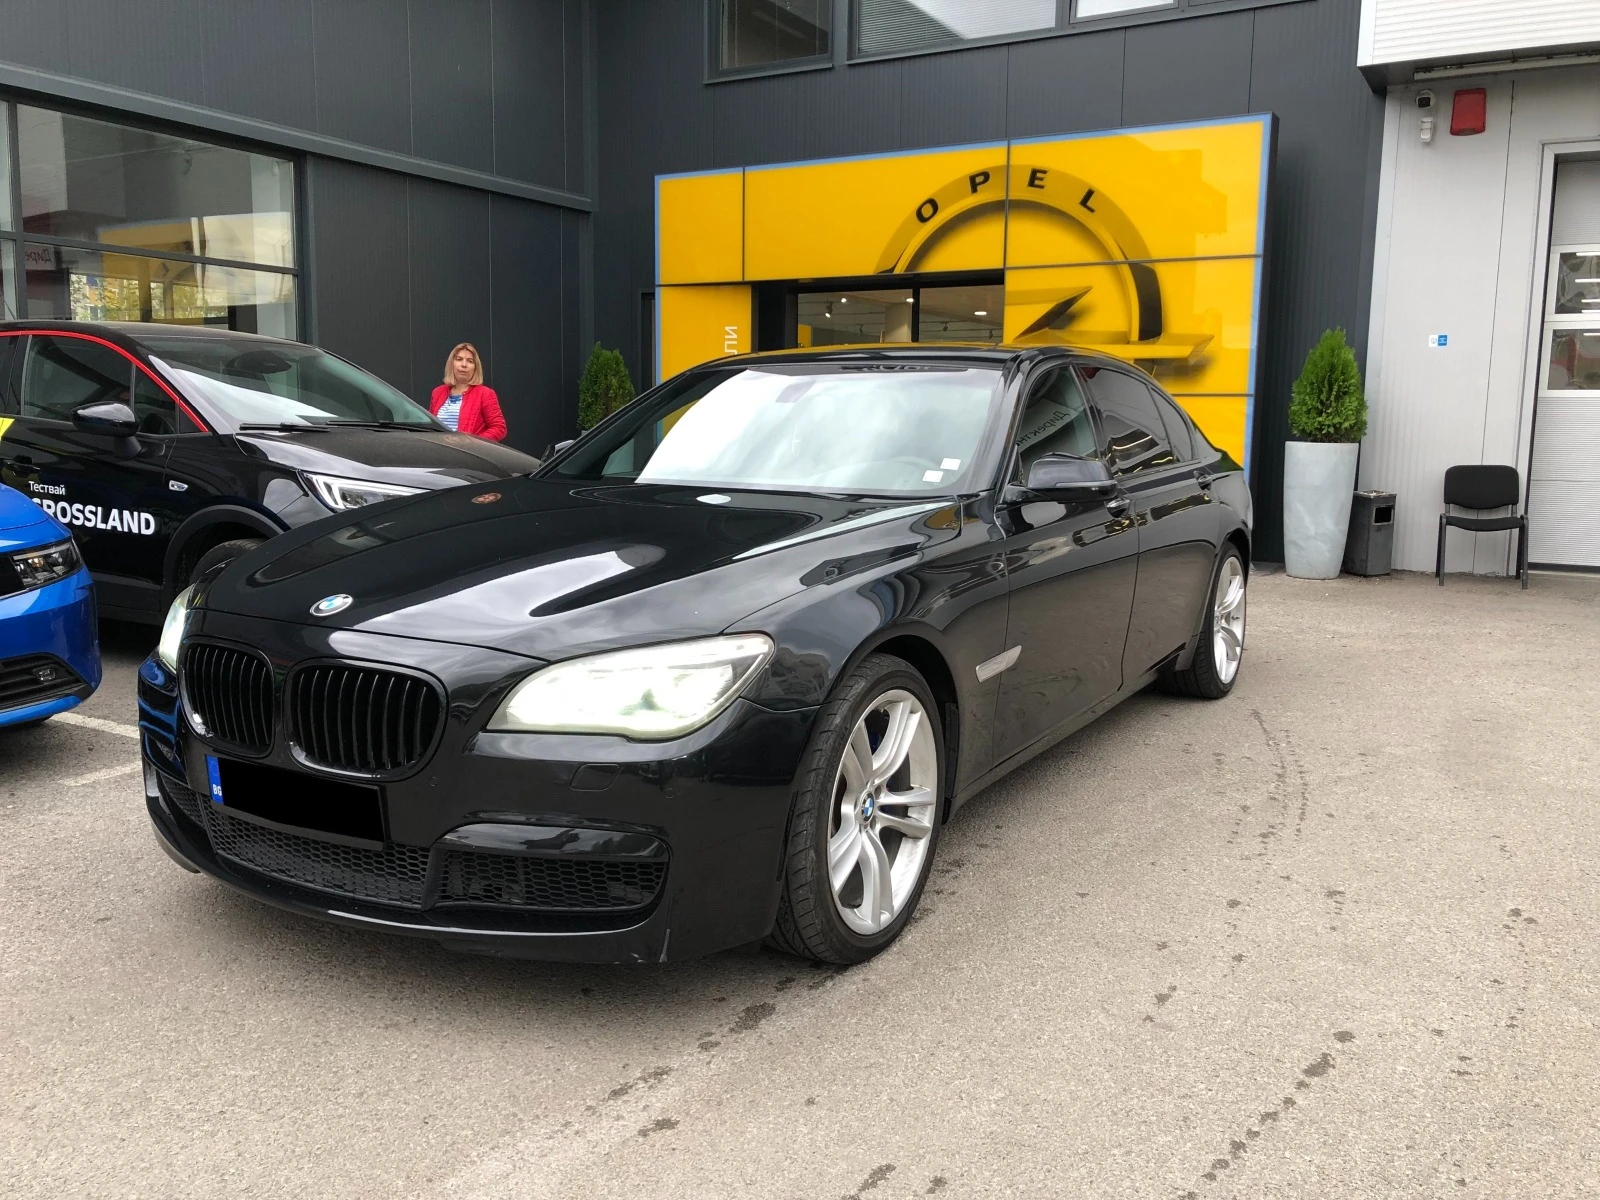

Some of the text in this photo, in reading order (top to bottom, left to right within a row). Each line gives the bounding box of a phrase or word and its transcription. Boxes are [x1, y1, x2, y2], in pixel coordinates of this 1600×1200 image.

[916, 168, 1097, 223] OPEL
[28, 480, 66, 496] Тествай
[212, 783, 223, 797] BG
